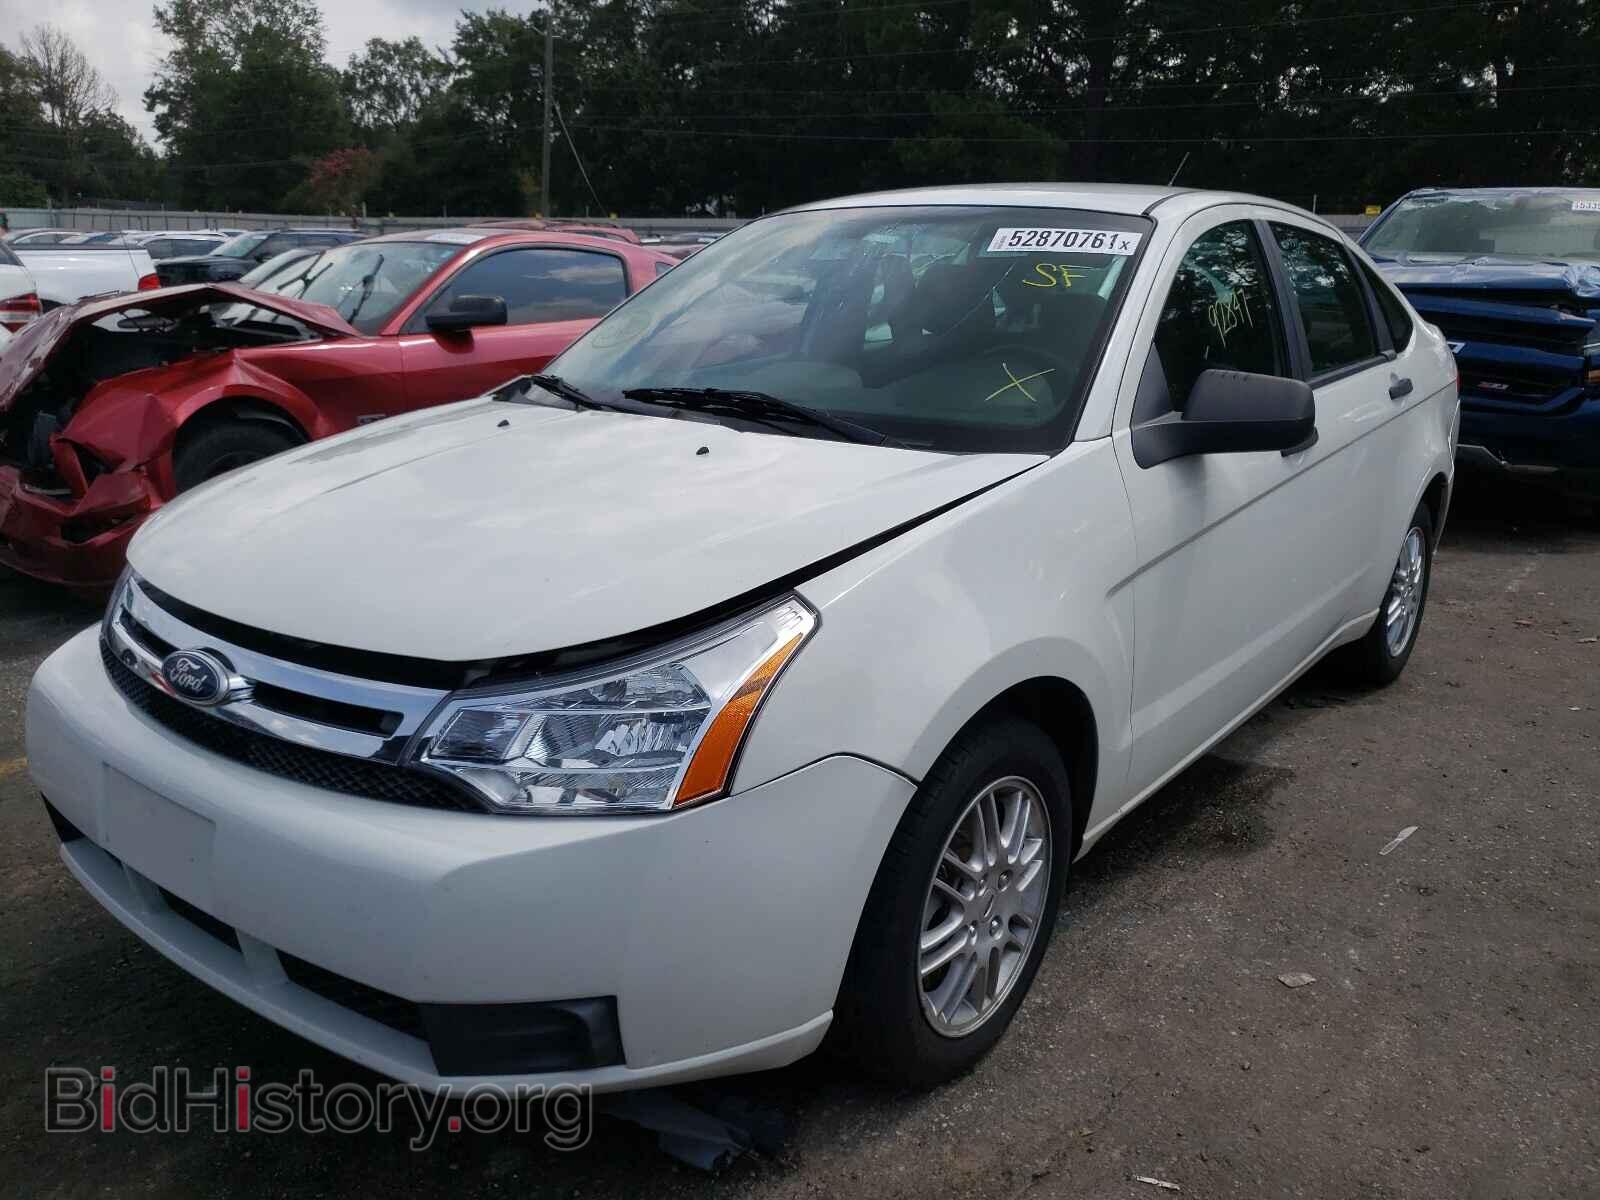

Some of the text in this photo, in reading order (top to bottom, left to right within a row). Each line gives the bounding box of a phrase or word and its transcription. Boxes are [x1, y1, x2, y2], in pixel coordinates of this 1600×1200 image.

[1008, 229, 1118, 250] 52870761
[1022, 263, 1090, 288] SF
[170, 657, 208, 692] Ford
